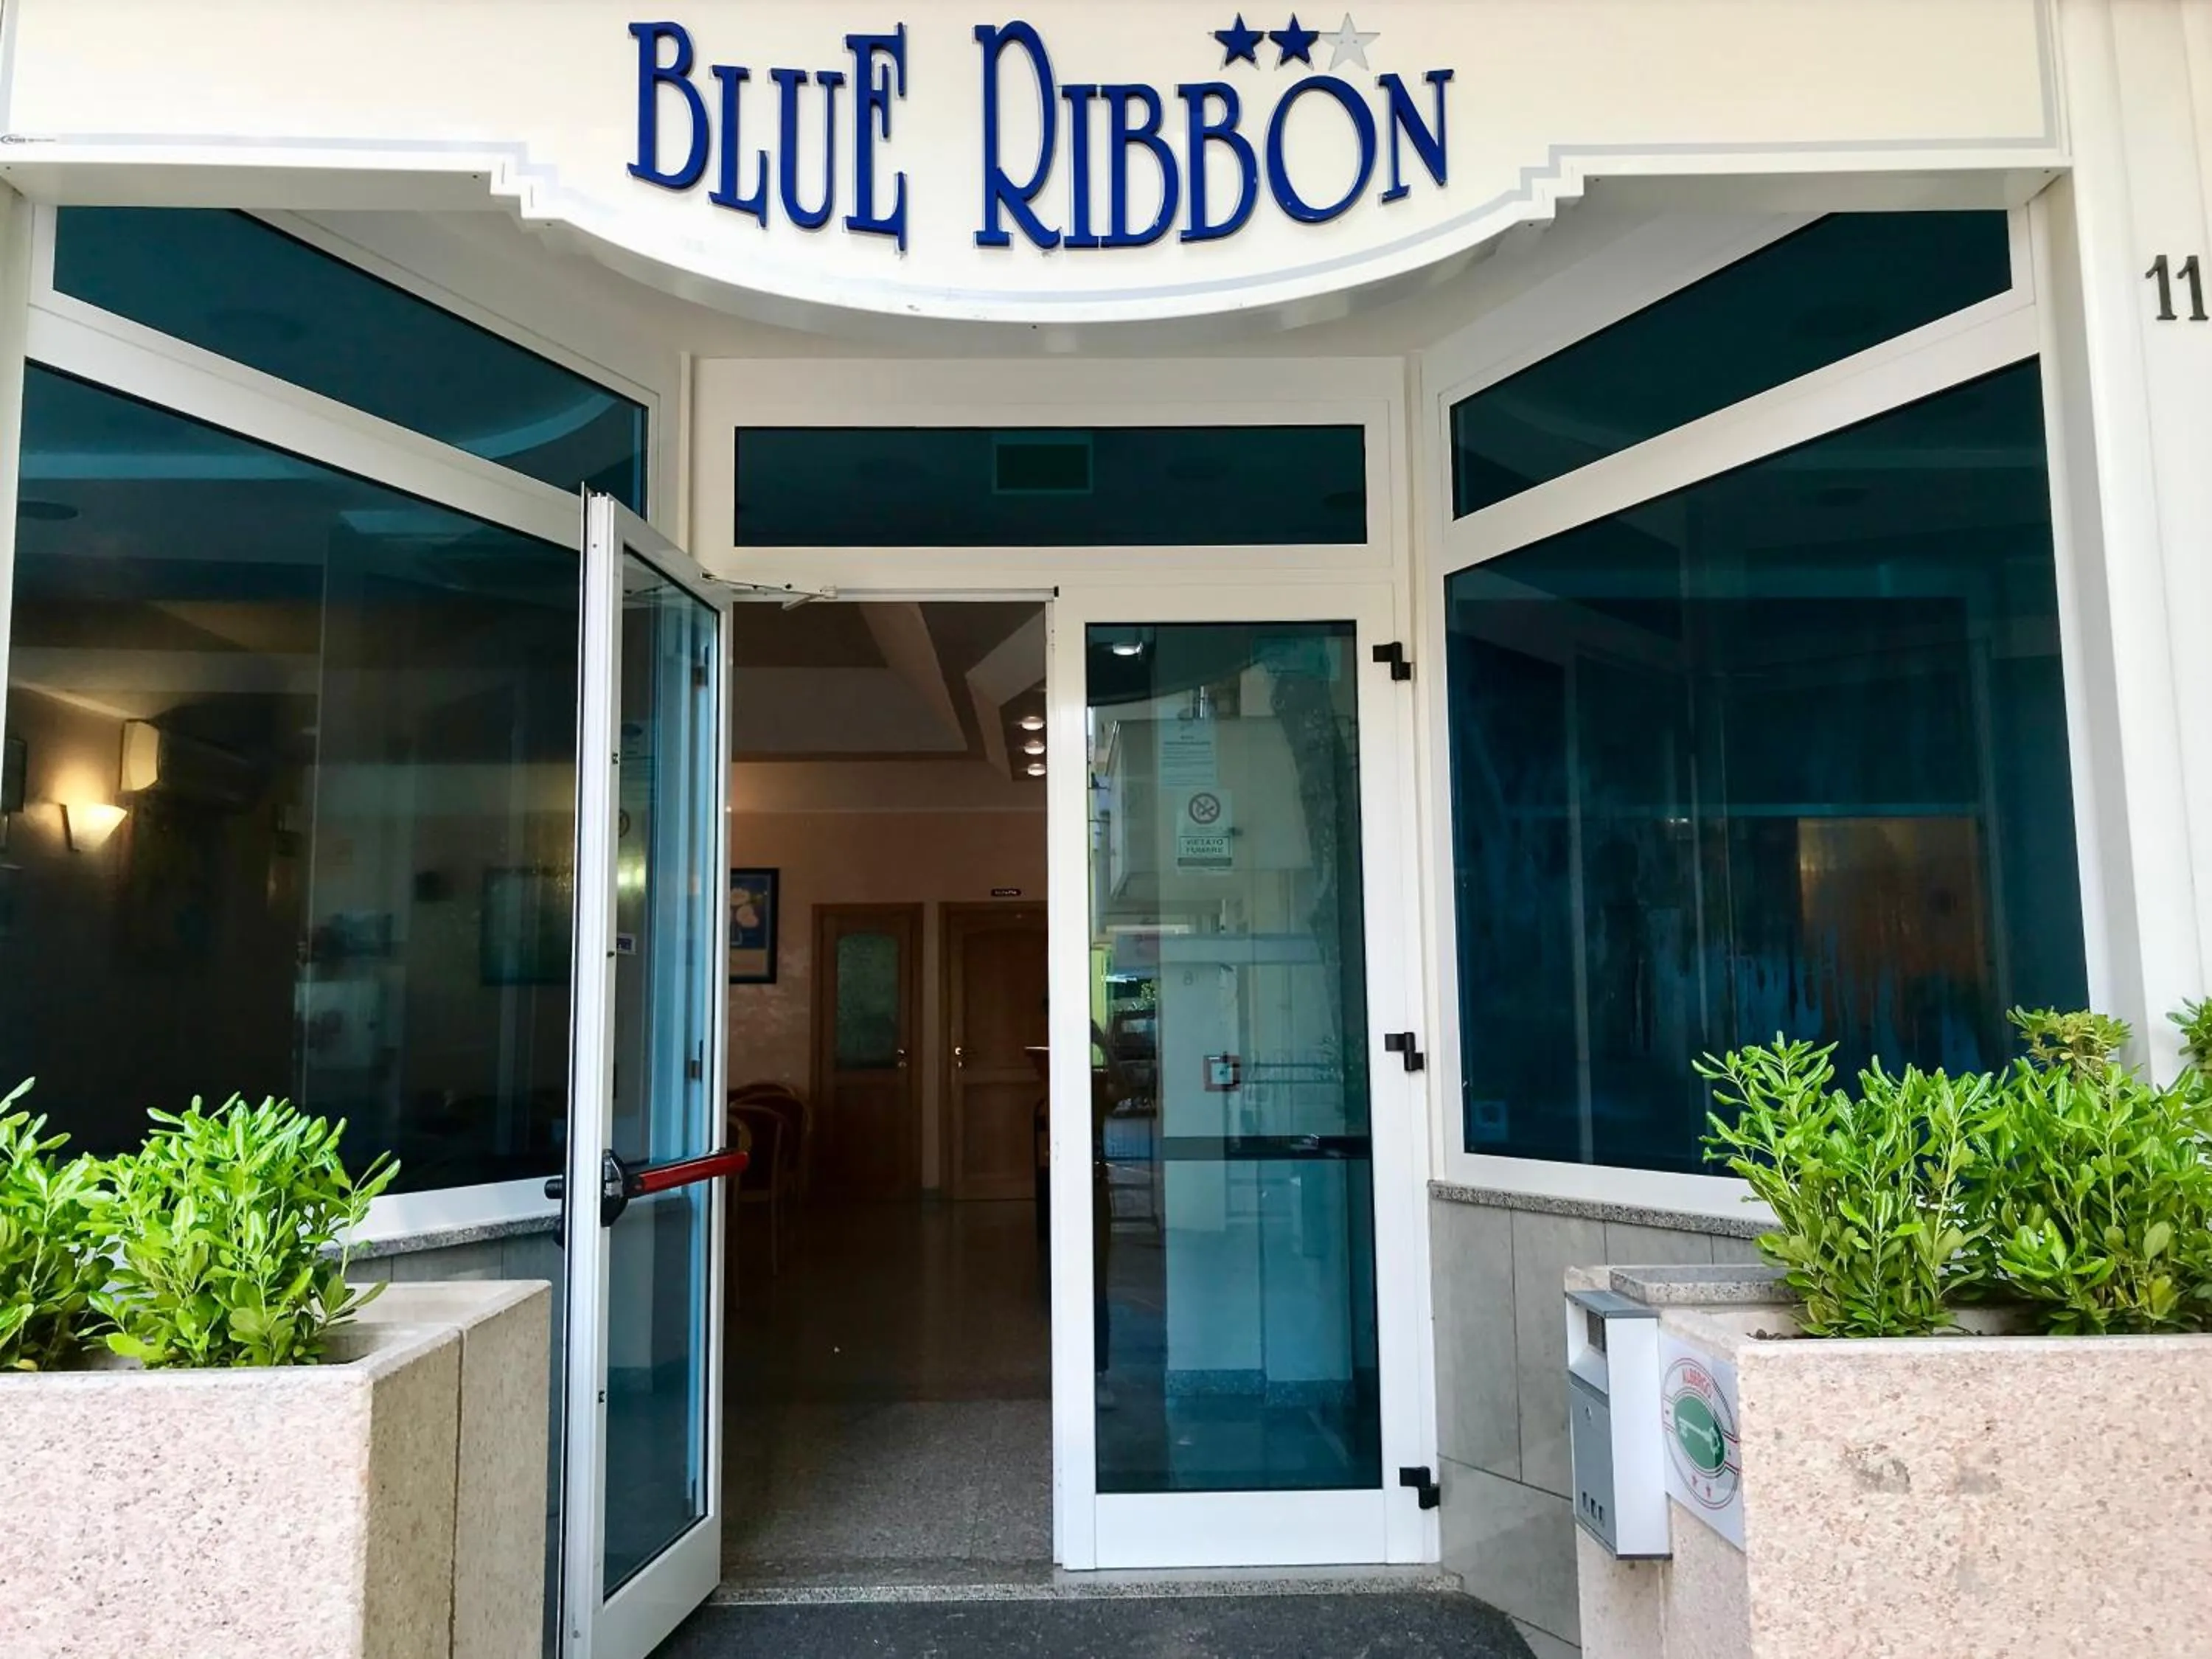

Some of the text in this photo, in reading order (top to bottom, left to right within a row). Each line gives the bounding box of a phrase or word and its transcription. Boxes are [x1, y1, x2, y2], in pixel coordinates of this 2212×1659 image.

[626, 19, 1455, 252] BLUE RIBBON
[2145, 254, 2210, 321] 11
